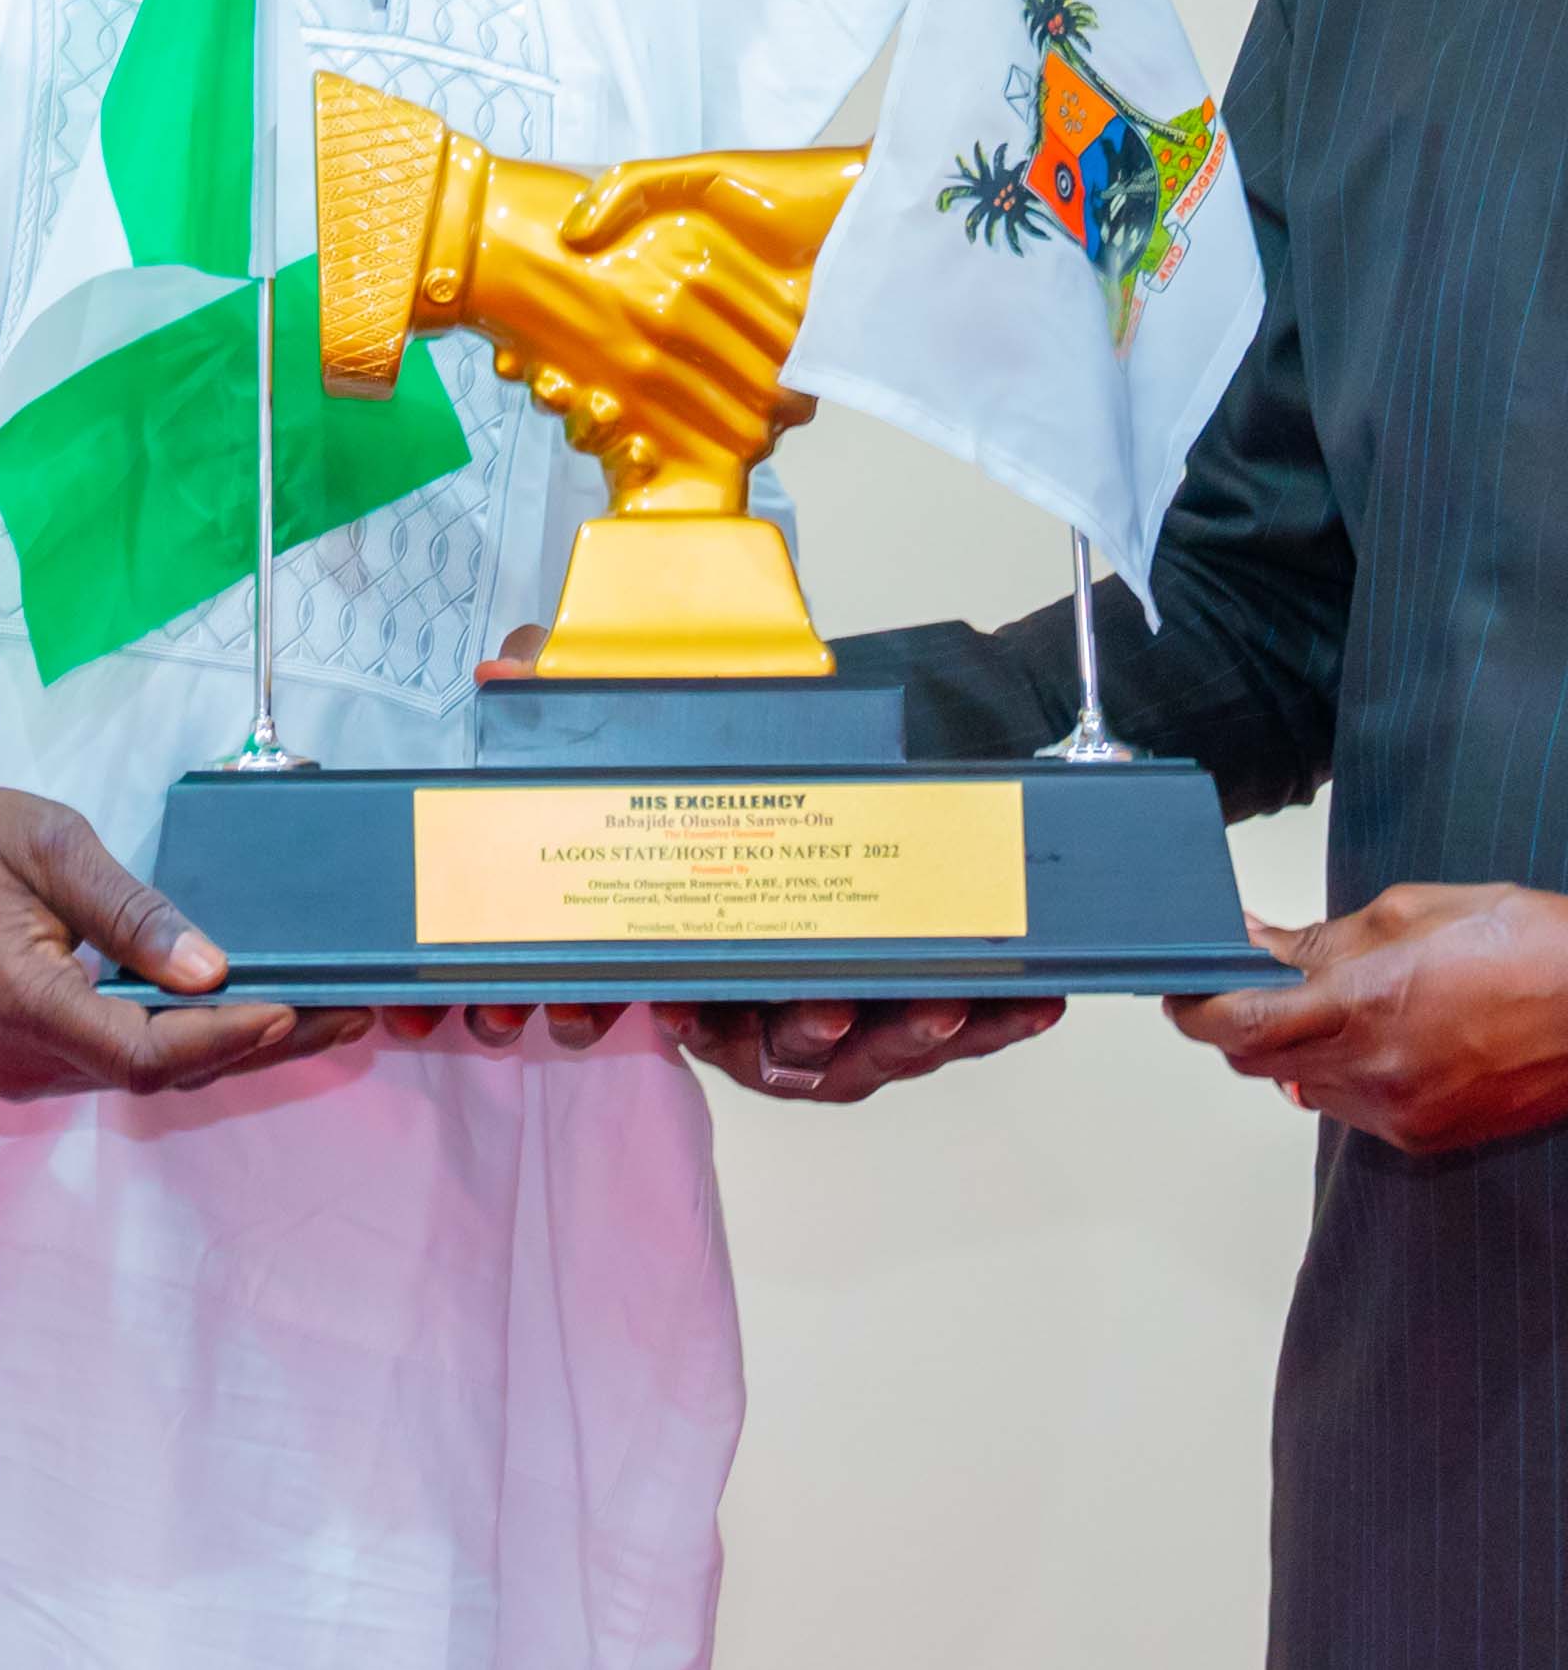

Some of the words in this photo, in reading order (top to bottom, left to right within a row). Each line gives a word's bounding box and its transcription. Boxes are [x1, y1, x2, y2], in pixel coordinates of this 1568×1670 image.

[1158, 244, 1184, 283] AND
[1175, 130, 1226, 219] PROGRESS
[630, 795, 668, 811] HIS
[675, 794, 806, 811] EXCELLENCY
[605, 814, 675, 831] Babajide
[680, 814, 741, 829] Olusola
[745, 813, 834, 828] Sanwo-Olu
[540, 846, 606, 863] LAGOS
[610, 845, 728, 861] STATE/HOST
[733, 845, 774, 860] EKO
[779, 844, 852, 859] NAFEST
[863, 843, 900, 859] 2022
[563, 894, 609, 905] Director
[664, 893, 711, 904] National
[714, 893, 758, 903] Council
[811, 892, 833, 903] And
[836, 892, 880, 903] Culture
